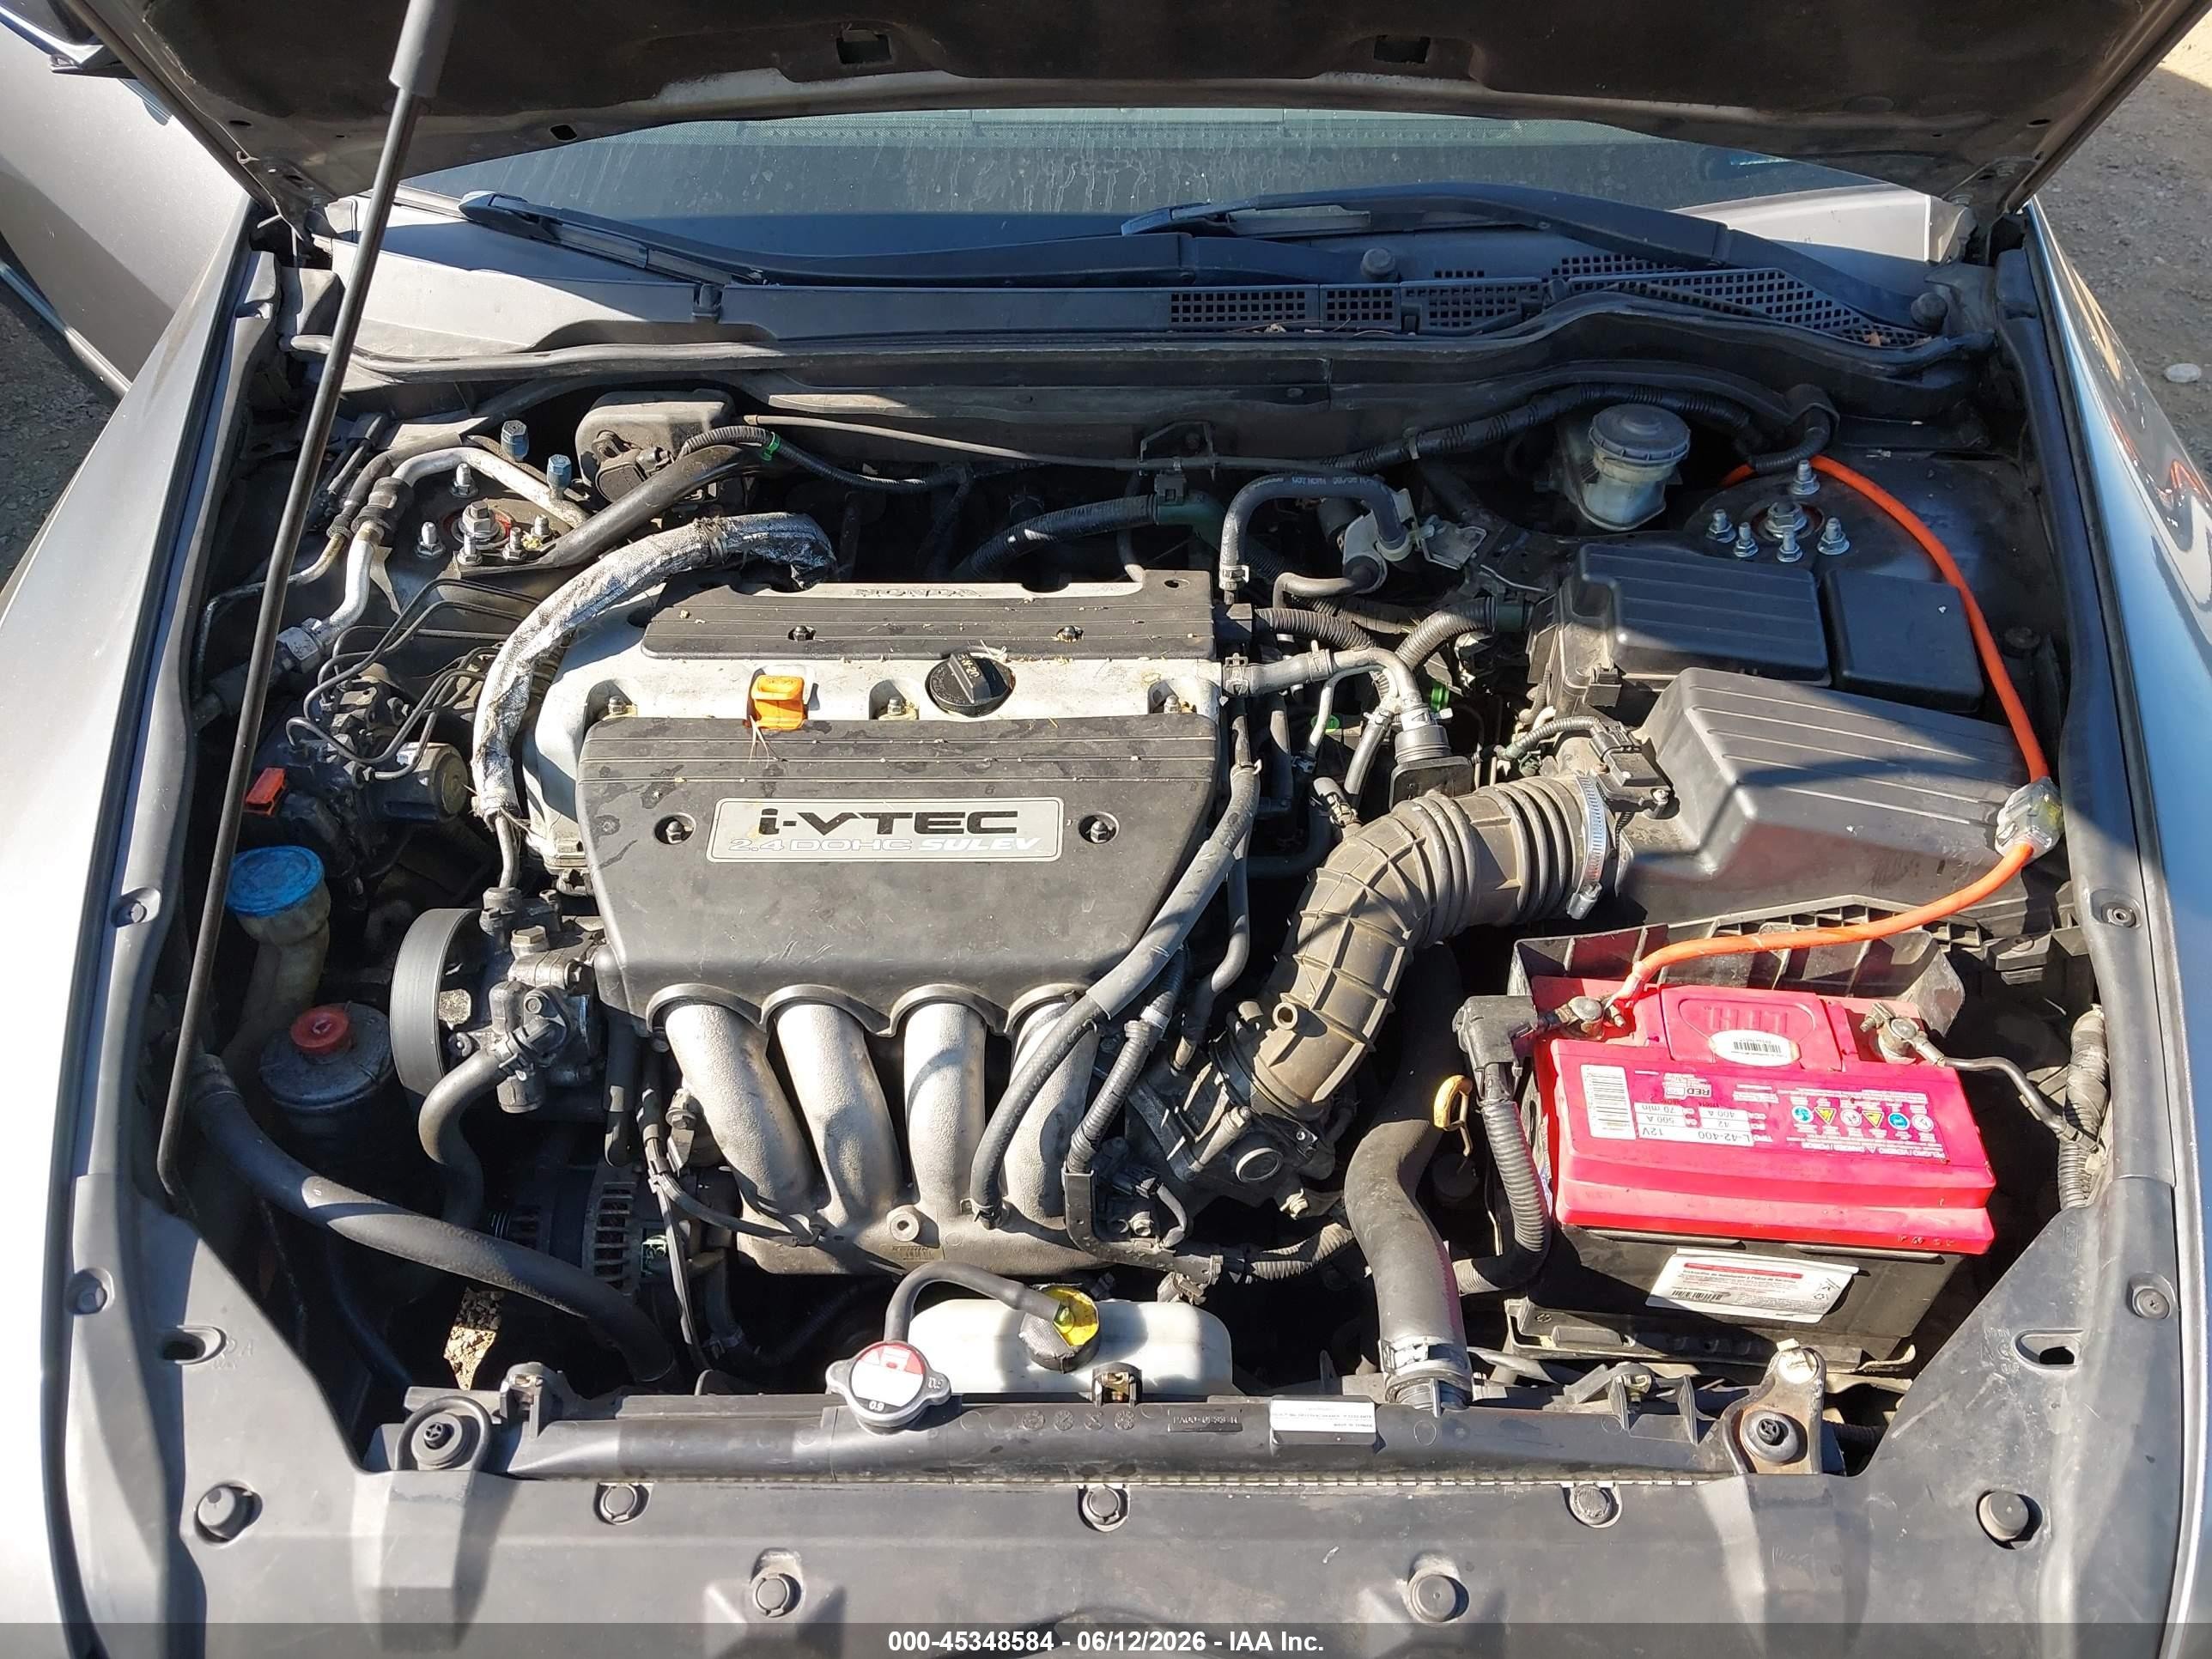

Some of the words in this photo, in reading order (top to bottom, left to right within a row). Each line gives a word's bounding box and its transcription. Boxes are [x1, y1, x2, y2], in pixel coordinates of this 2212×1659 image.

[854, 588, 981, 598] HONDA
[758, 808, 1019, 836] i-VTEC
[728, 839, 785, 852] 2.4
[789, 839, 914, 852] DOHC
[918, 837, 1042, 851] SULEV
[1687, 1087, 1711, 1096] RED
[1641, 1104, 1661, 1113] min
[1662, 1105, 1676, 1114] 70
[1717, 1120, 1730, 1128] 42
[1642, 1127, 1664, 1137] 12V
[1697, 1130, 1751, 1142] L-42-400
[868, 1401, 884, 1411] 0.9
